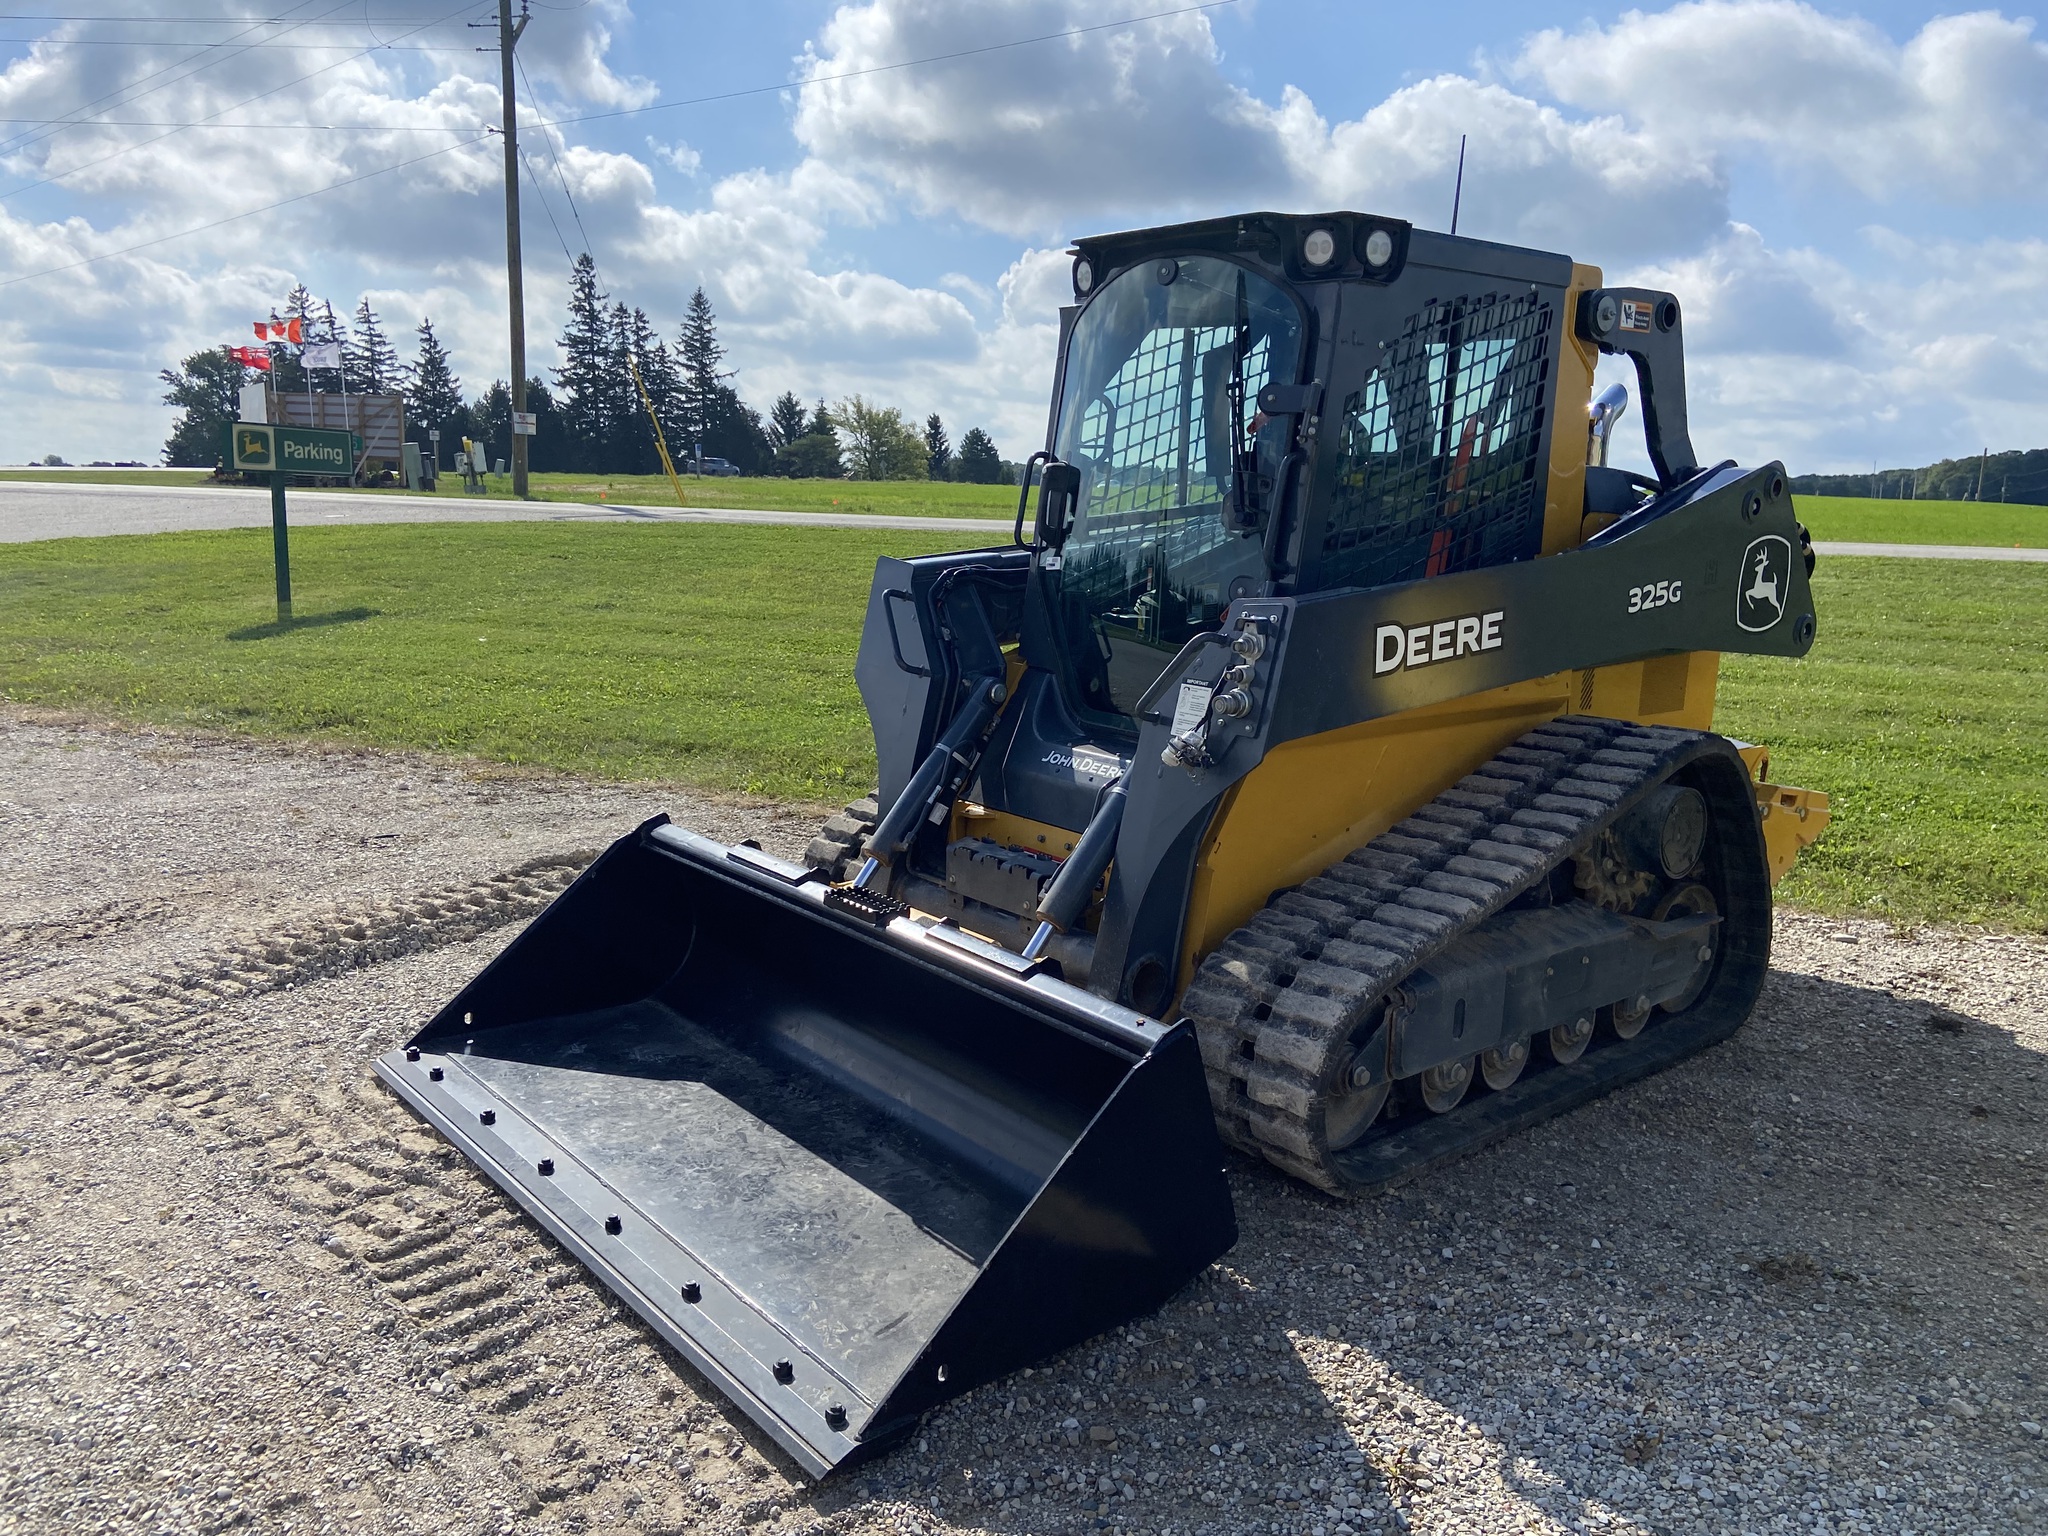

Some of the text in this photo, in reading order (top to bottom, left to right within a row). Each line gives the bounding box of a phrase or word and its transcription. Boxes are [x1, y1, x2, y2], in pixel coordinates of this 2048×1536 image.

[284, 440, 344, 465] Parking
[1627, 580, 1682, 614] 325G
[1374, 610, 1504, 674] DEERE
[1186, 678, 1210, 687] IMPORTANT
[1041, 750, 1080, 769] JOHN
